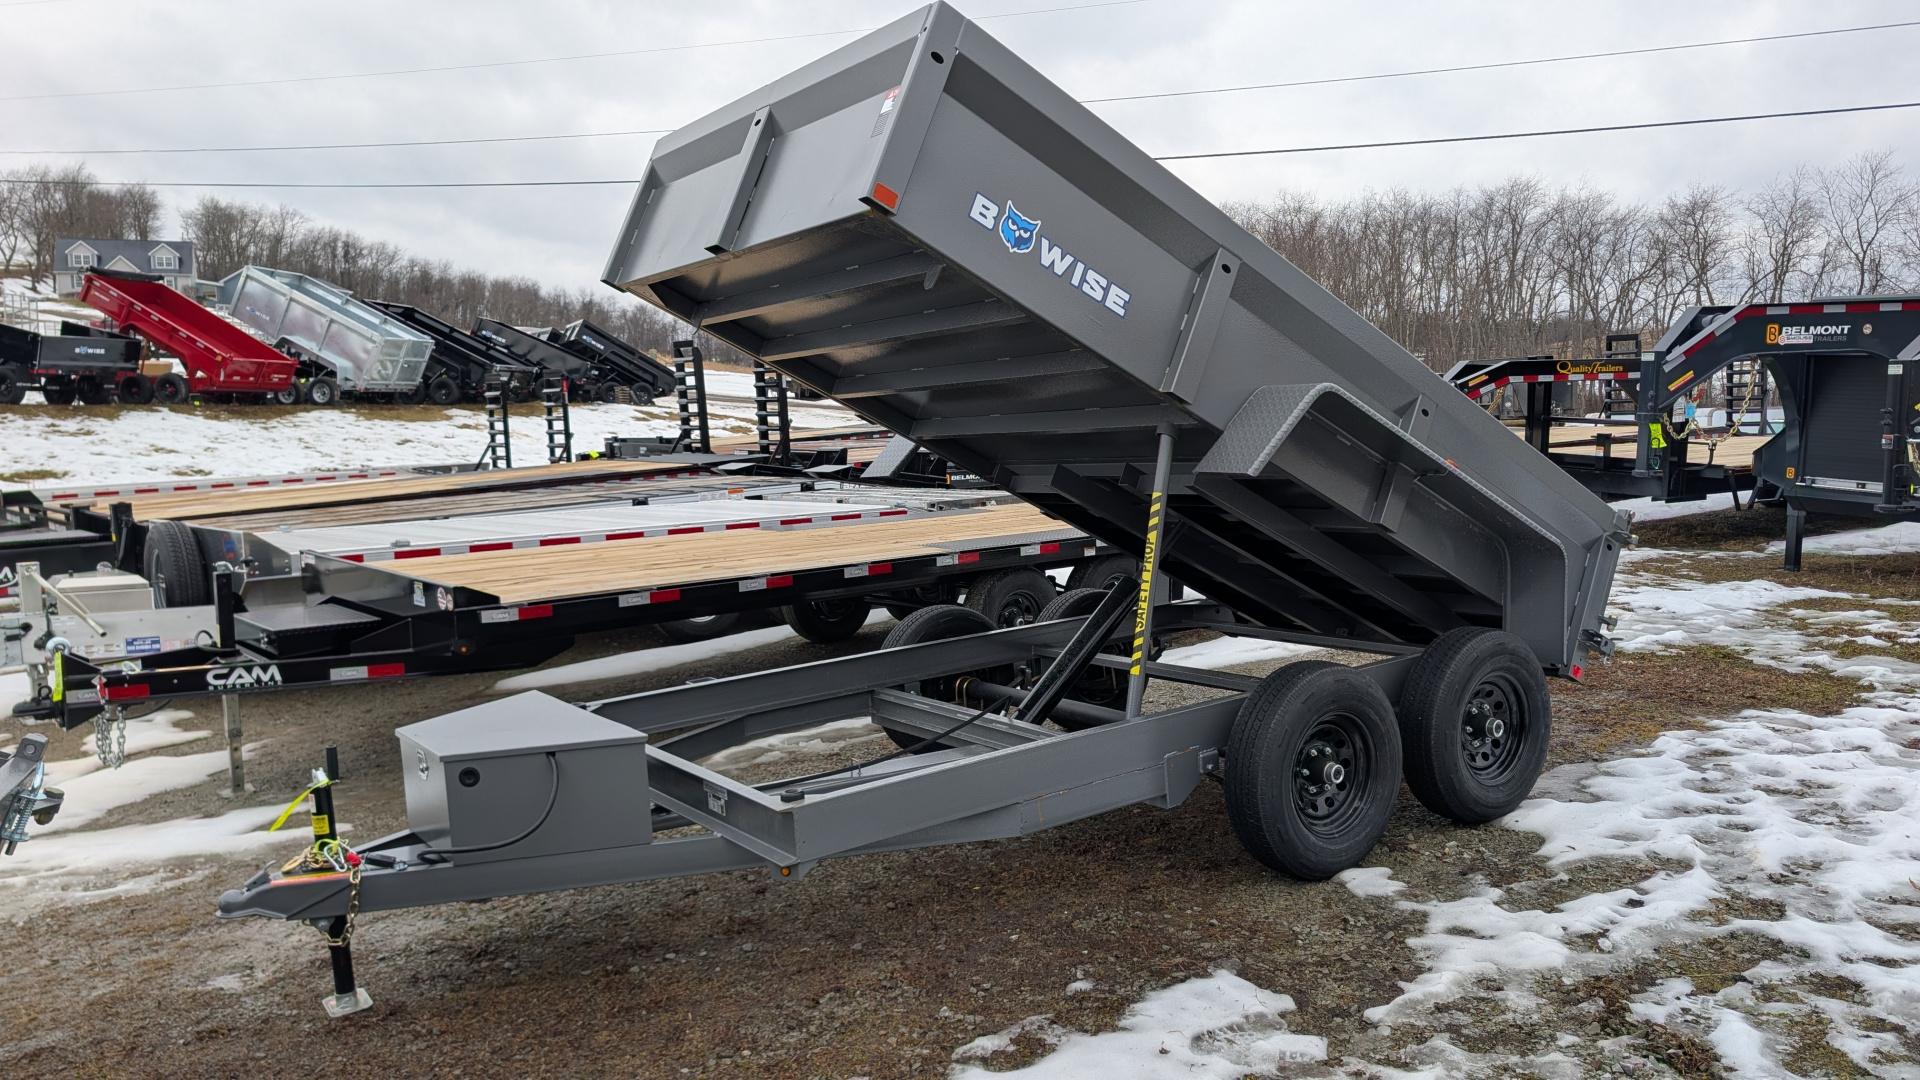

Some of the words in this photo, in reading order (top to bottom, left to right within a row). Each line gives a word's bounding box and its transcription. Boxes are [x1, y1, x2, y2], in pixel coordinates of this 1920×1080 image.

[1781, 325, 1851, 336] BELMONT
[1556, 360, 1593, 375] Quality
[1590, 360, 1624, 373] Trailers
[1142, 536, 1156, 573] PROP
[1135, 578, 1150, 630] SAFETY
[206, 664, 283, 686] CAM
[208, 680, 283, 691] SUPERLINE
